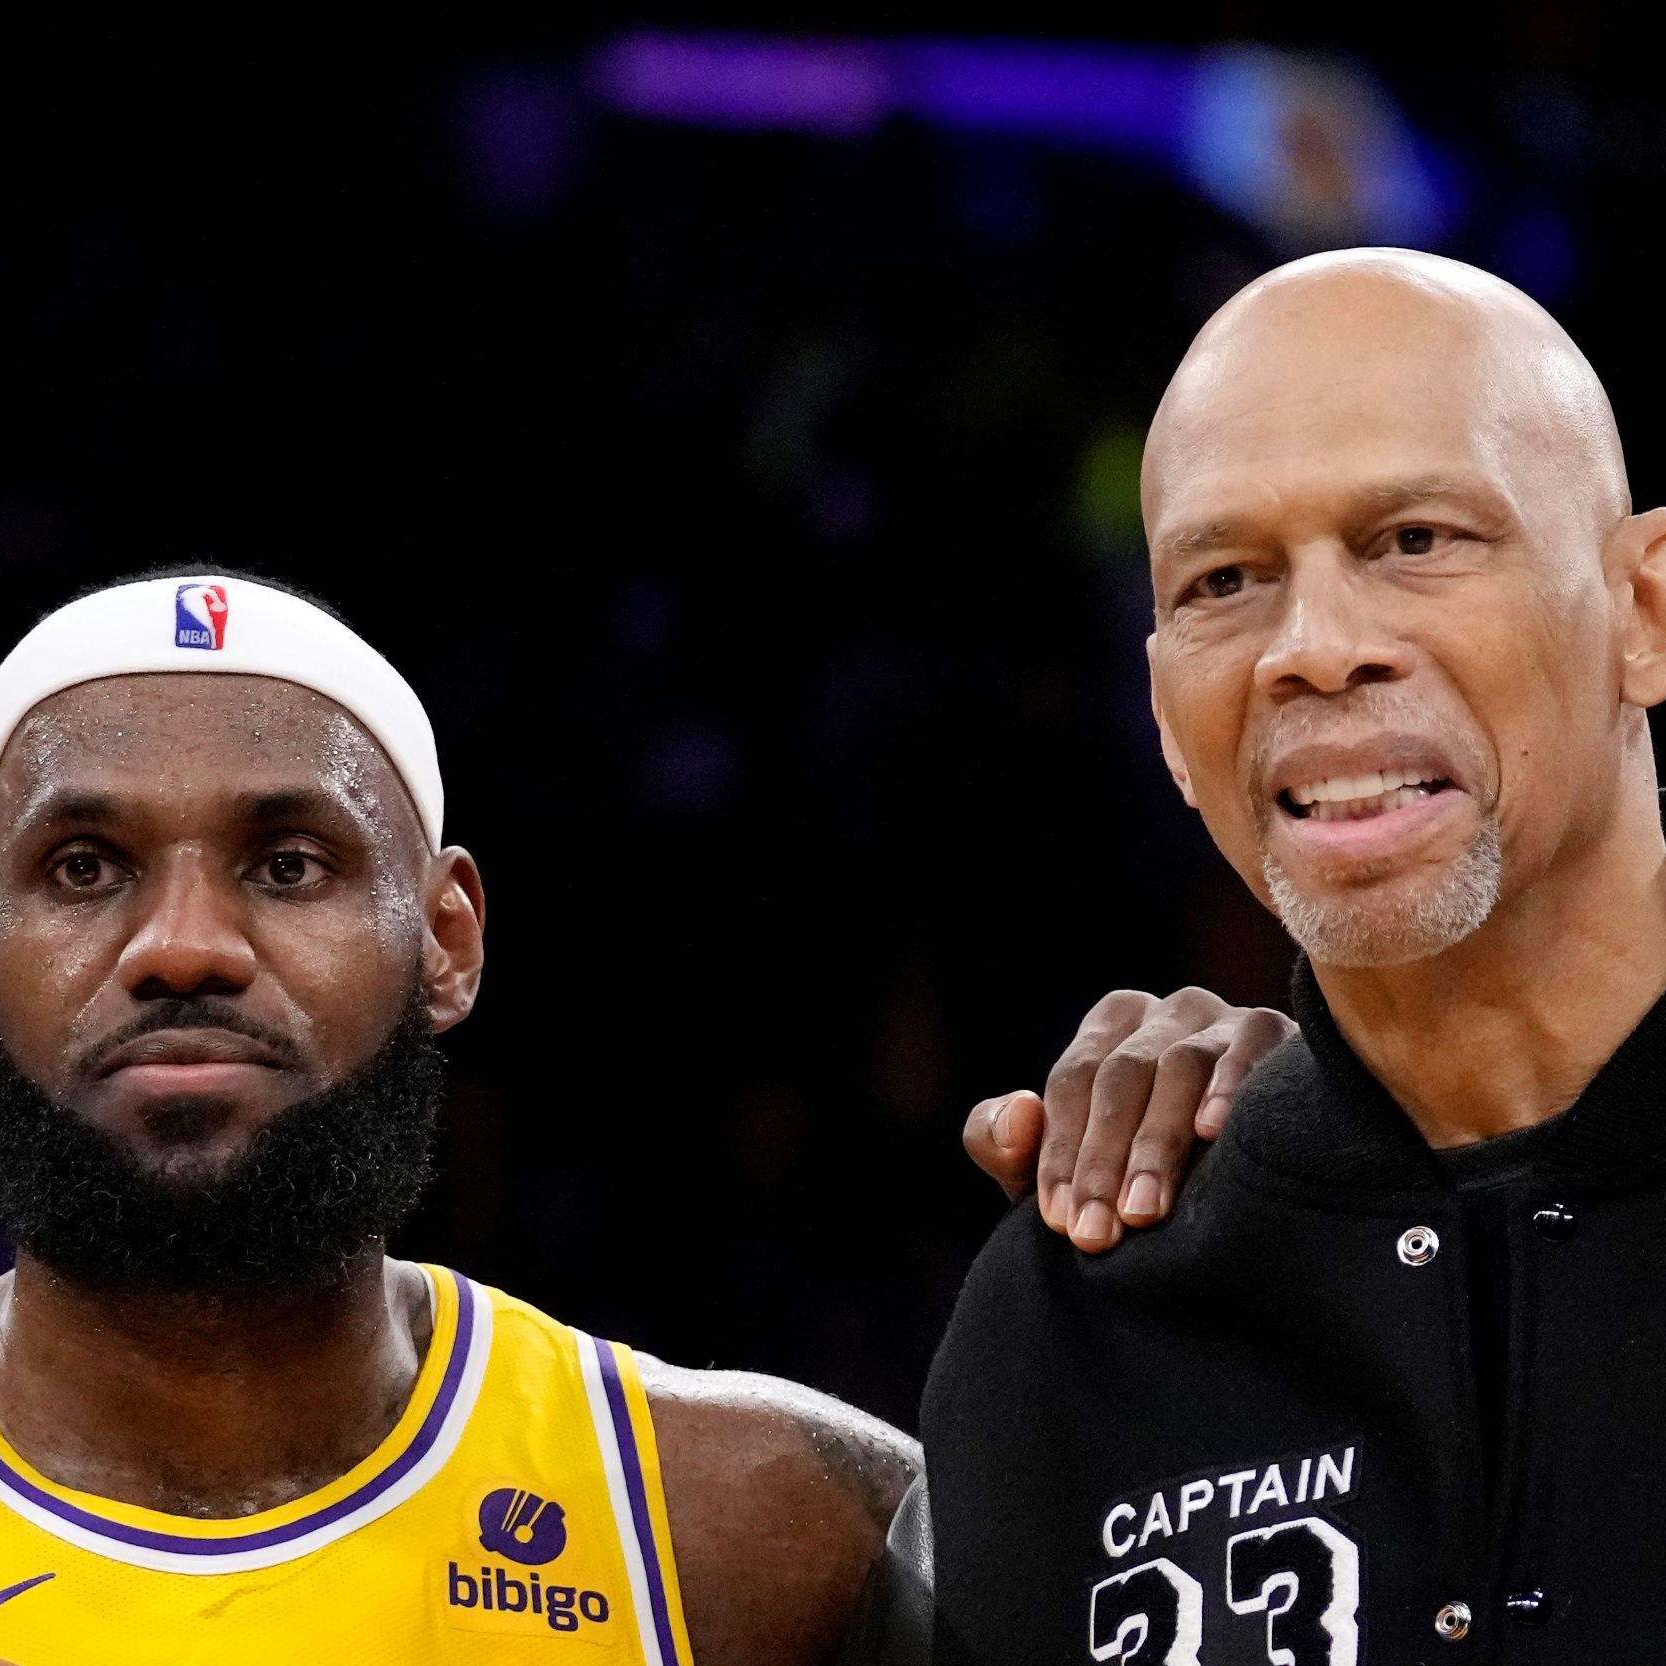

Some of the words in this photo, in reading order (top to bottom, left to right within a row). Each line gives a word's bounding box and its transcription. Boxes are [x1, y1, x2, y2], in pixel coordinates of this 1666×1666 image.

[179, 629, 210, 645] NBA
[1102, 1447, 1355, 1557] CAPTAIN
[448, 1561, 610, 1632] bibigo
